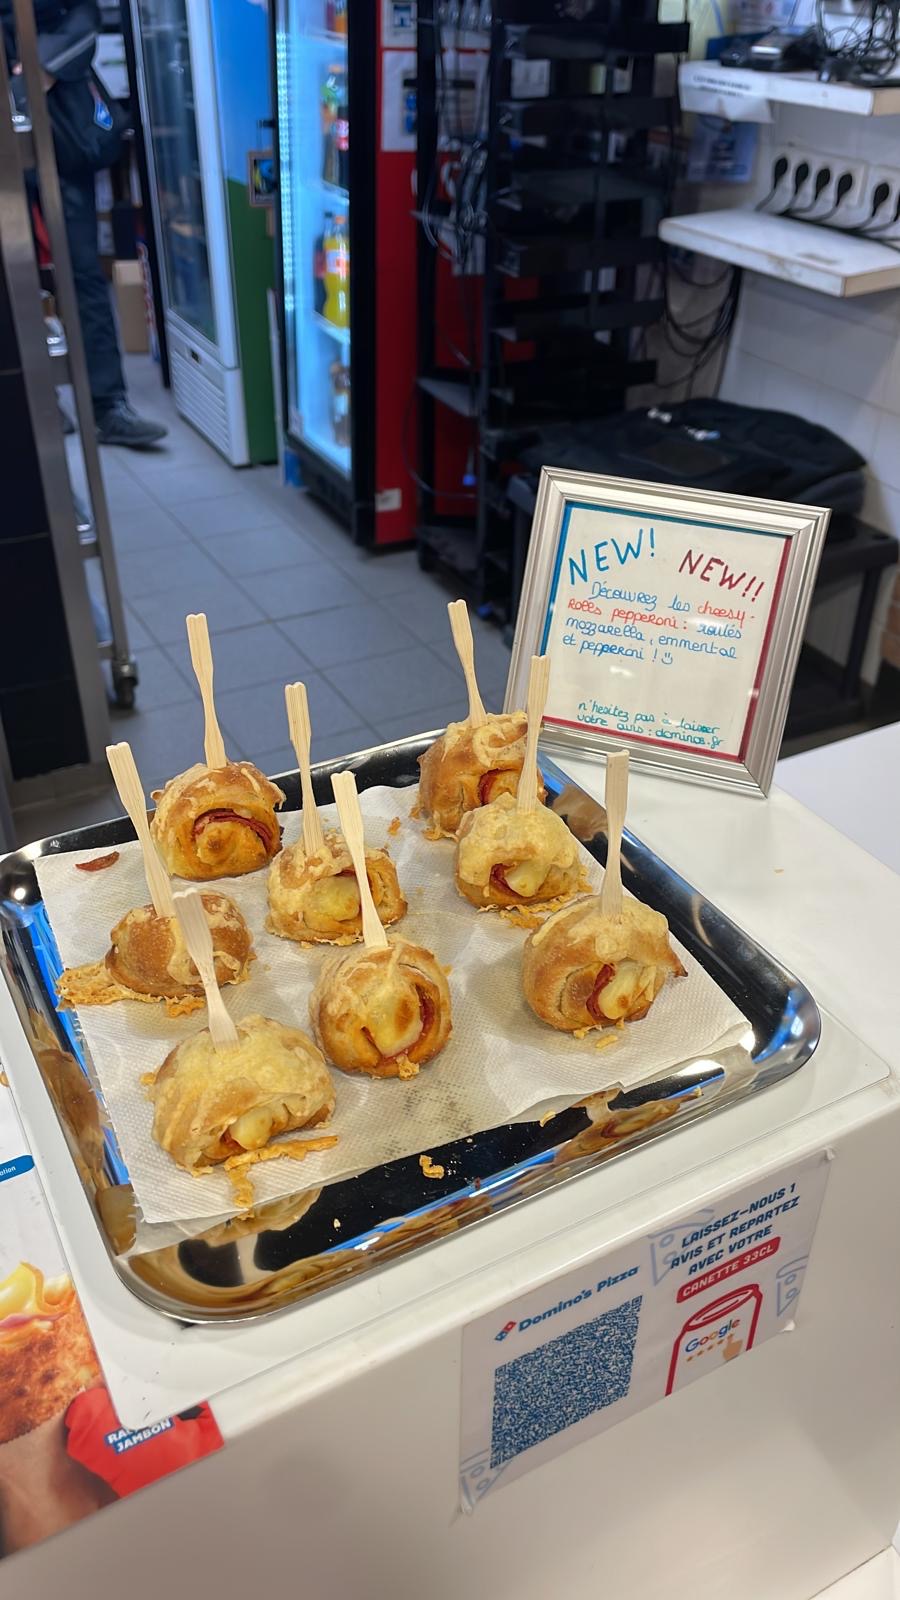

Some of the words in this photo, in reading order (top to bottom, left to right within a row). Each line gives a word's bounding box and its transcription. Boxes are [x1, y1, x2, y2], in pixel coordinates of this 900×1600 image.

[568, 527, 656, 585] NEW!
[678, 549, 765, 602] NEW!!
[668, 594, 691, 612] les
[563, 633, 576, 646] et
[658, 634, 737, 659] emmental
[697, 623, 742, 639] roulés
[577, 713, 609, 727] votre
[634, 712, 655, 724] pas
[670, 1244, 704, 1269] AVIS
[707, 1233, 726, 1250] ET
[729, 1196, 800, 1239] REPARTEZ
[681, 1187, 786, 1248] LAISSEZ-NOUS
[790, 1183, 796, 1193] 1
[688, 1249, 724, 1276] AVEC
[728, 1224, 773, 1254] VOTRE
[682, 1259, 740, 1297] CANETTE
[743, 1243, 775, 1265] 33CL
[517, 1288, 593, 1332] Domino's
[596, 1265, 640, 1292] Pizza
[685, 1319, 741, 1353] Google
[117, 1417, 172, 1452] JAMBON
